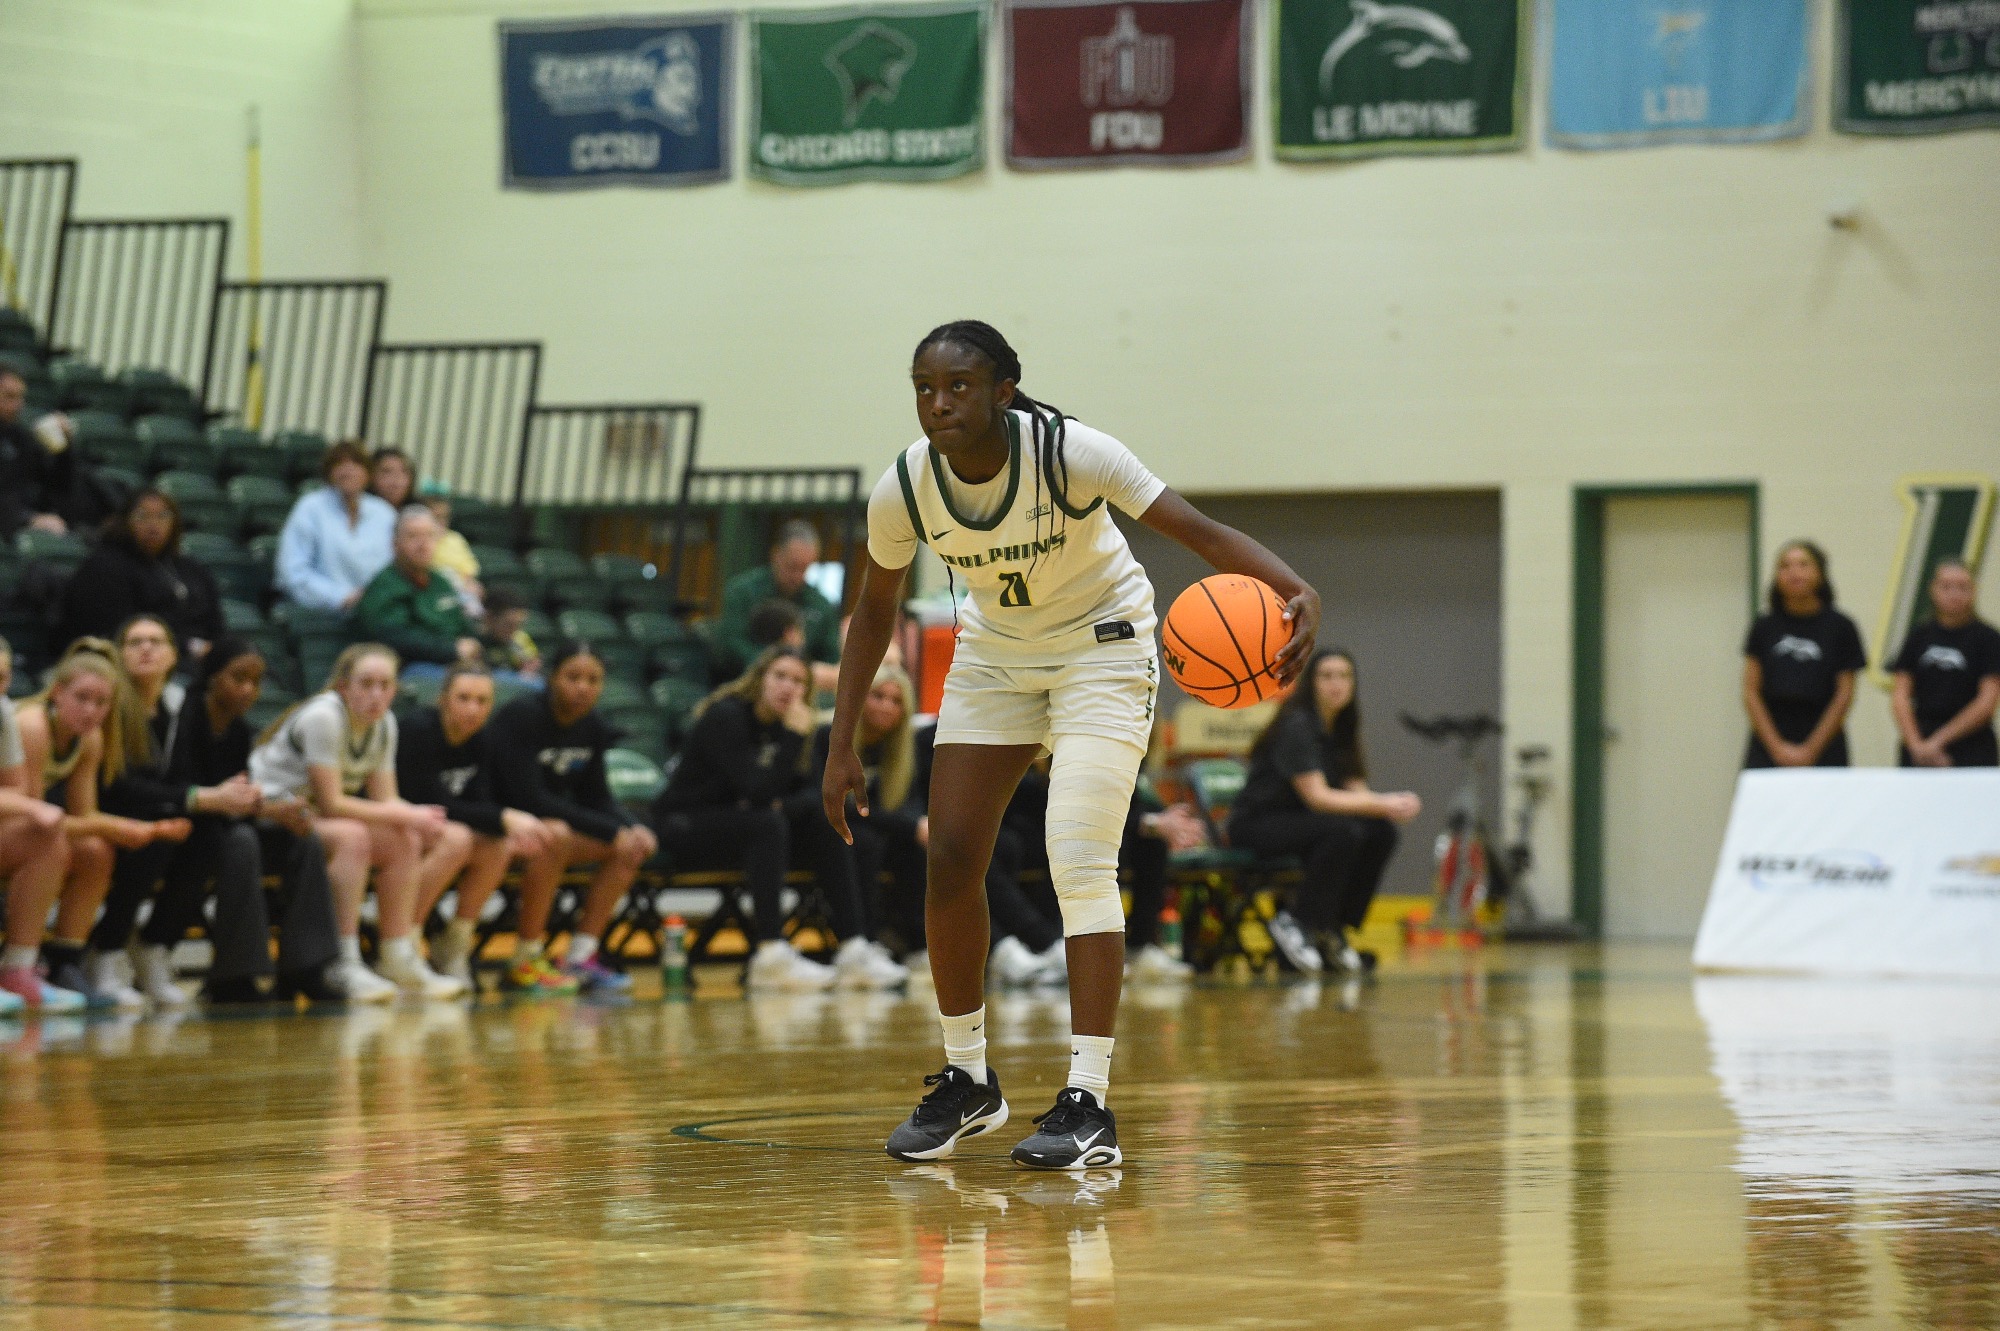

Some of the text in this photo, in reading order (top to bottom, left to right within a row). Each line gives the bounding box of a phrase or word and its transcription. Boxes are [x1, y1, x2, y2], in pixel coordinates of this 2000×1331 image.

[1314, 99, 1477, 140] LE MOYNE
[761, 131, 889, 165] CHICAGO
[1122, 625, 1130, 633] M
